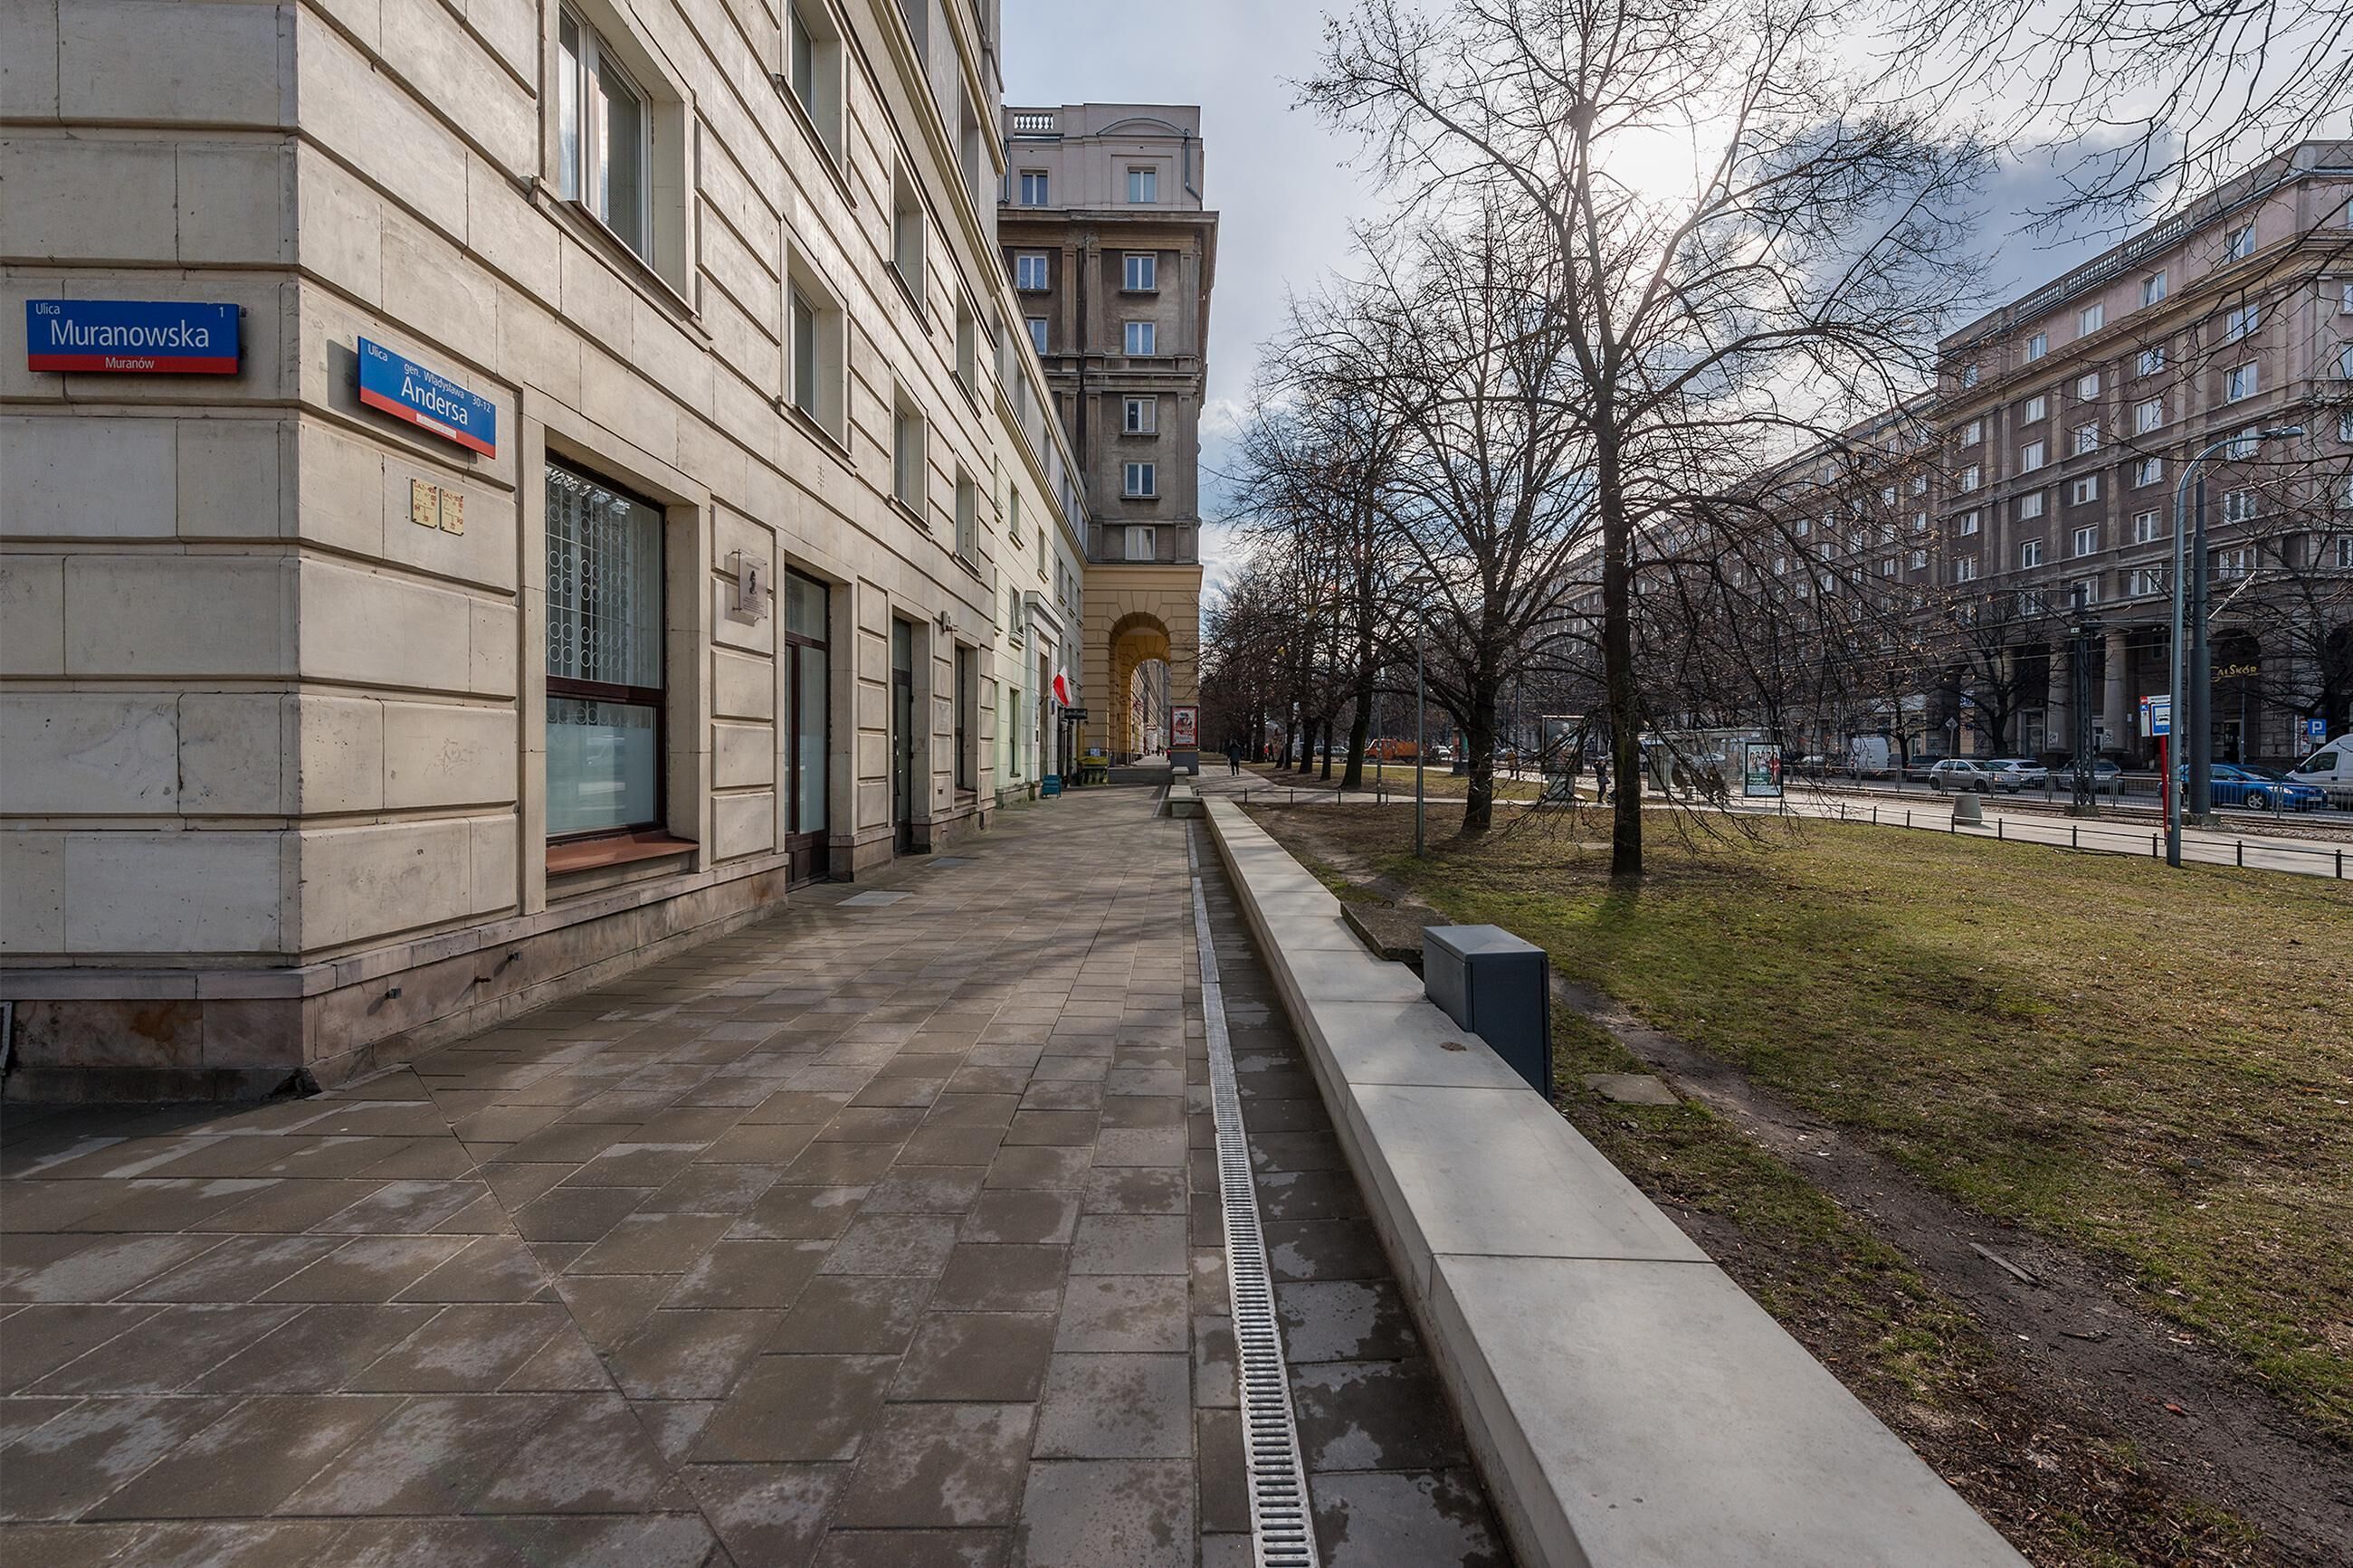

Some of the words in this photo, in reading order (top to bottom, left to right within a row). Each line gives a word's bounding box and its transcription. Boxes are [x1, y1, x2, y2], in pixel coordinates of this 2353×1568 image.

[35, 303, 61, 315] Ulica
[219, 306, 224, 318] 1
[51, 319, 209, 347] Muranowska
[367, 343, 388, 362] Ulica
[105, 356, 155, 369] Muranów
[404, 363, 421, 378] gen.
[424, 371, 465, 399] Władysława
[401, 375, 469, 426] Andersa
[472, 395, 491, 413] 30-12
[2312, 720, 2323, 734] P
